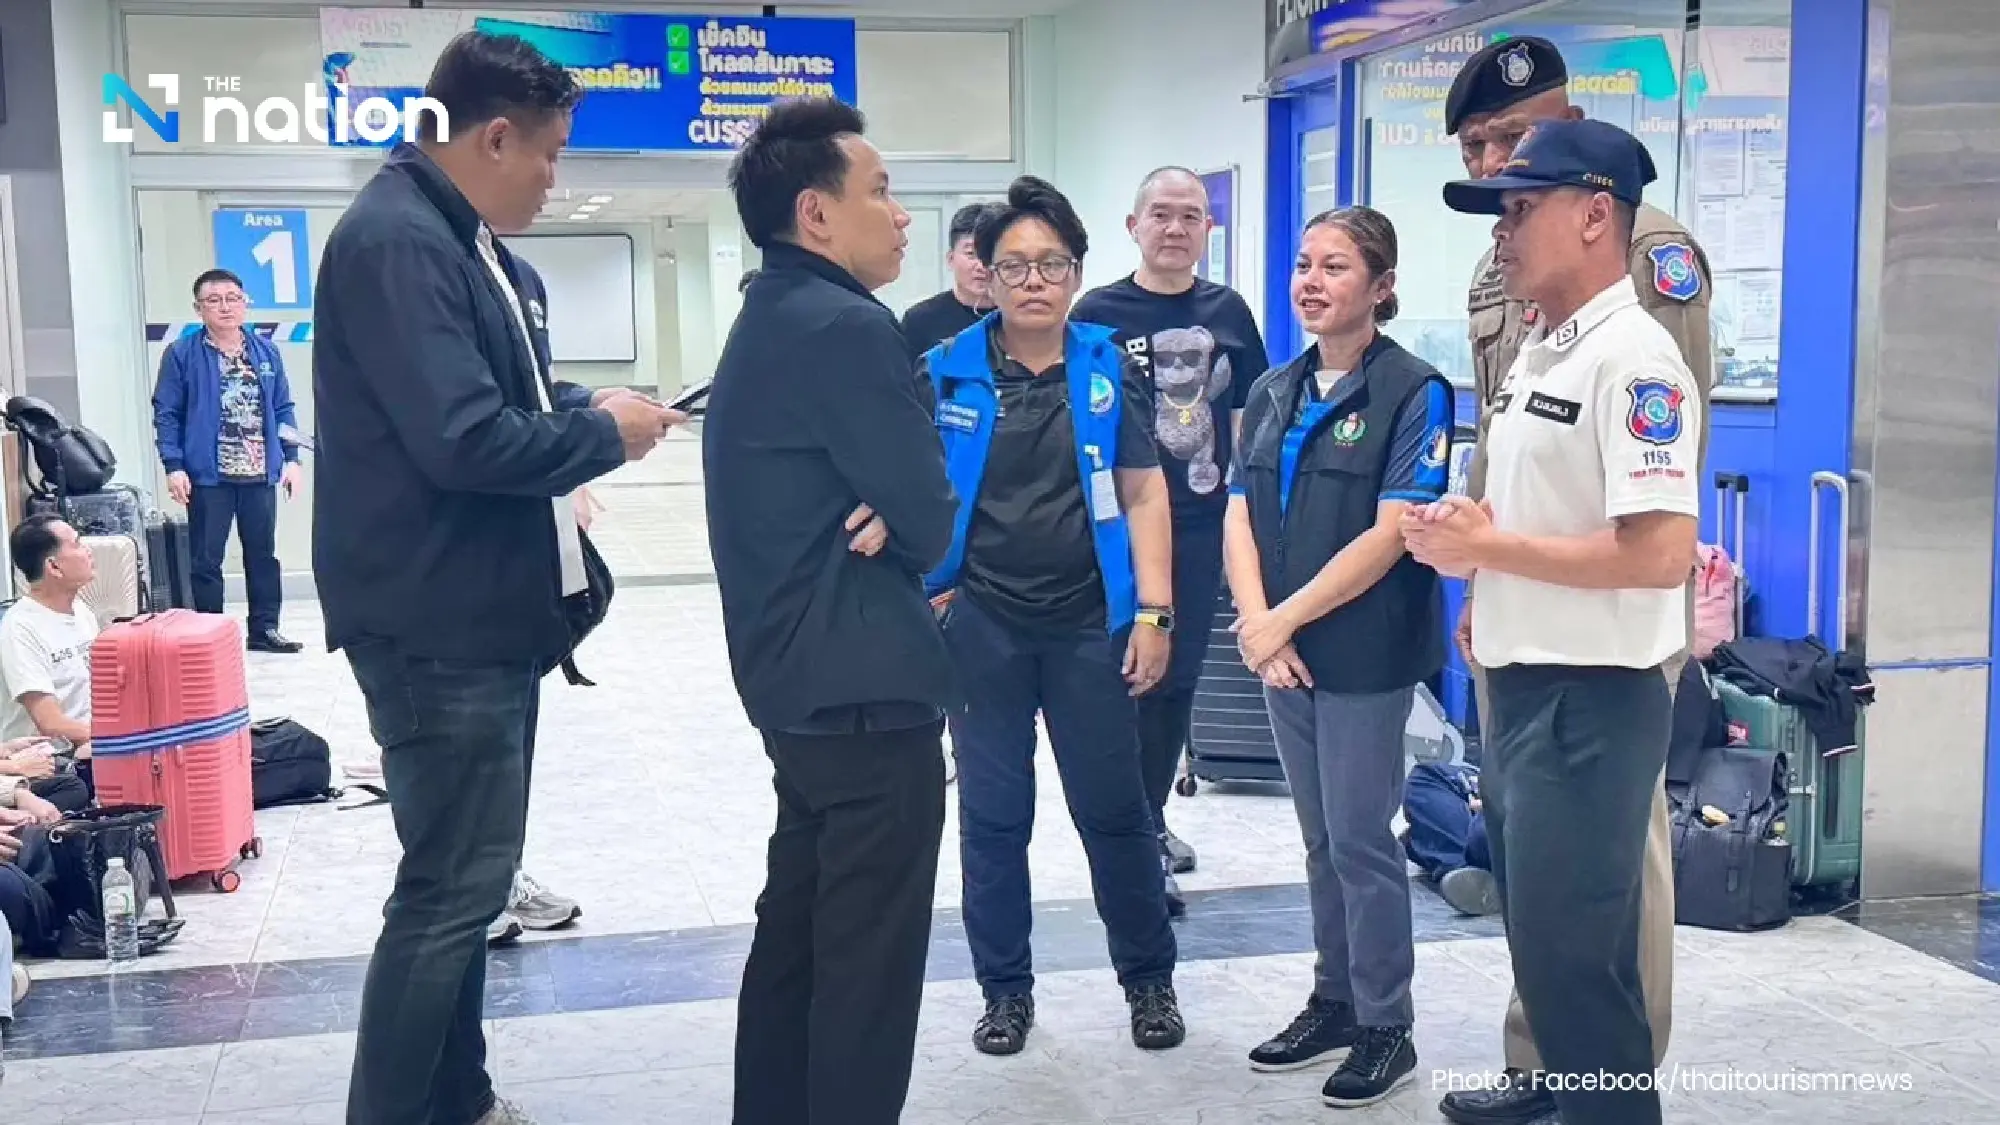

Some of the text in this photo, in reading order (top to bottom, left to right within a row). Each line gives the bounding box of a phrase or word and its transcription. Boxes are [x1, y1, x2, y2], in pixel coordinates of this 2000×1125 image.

[697, 20, 766, 48] เช็คอิน
[698, 47, 834, 74] โหลดสัมภาระ
[243, 212, 283, 226] Area
[252, 231, 297, 303] 1
[1125, 336, 1149, 378] BA
[1642, 450, 1672, 466] 1155
